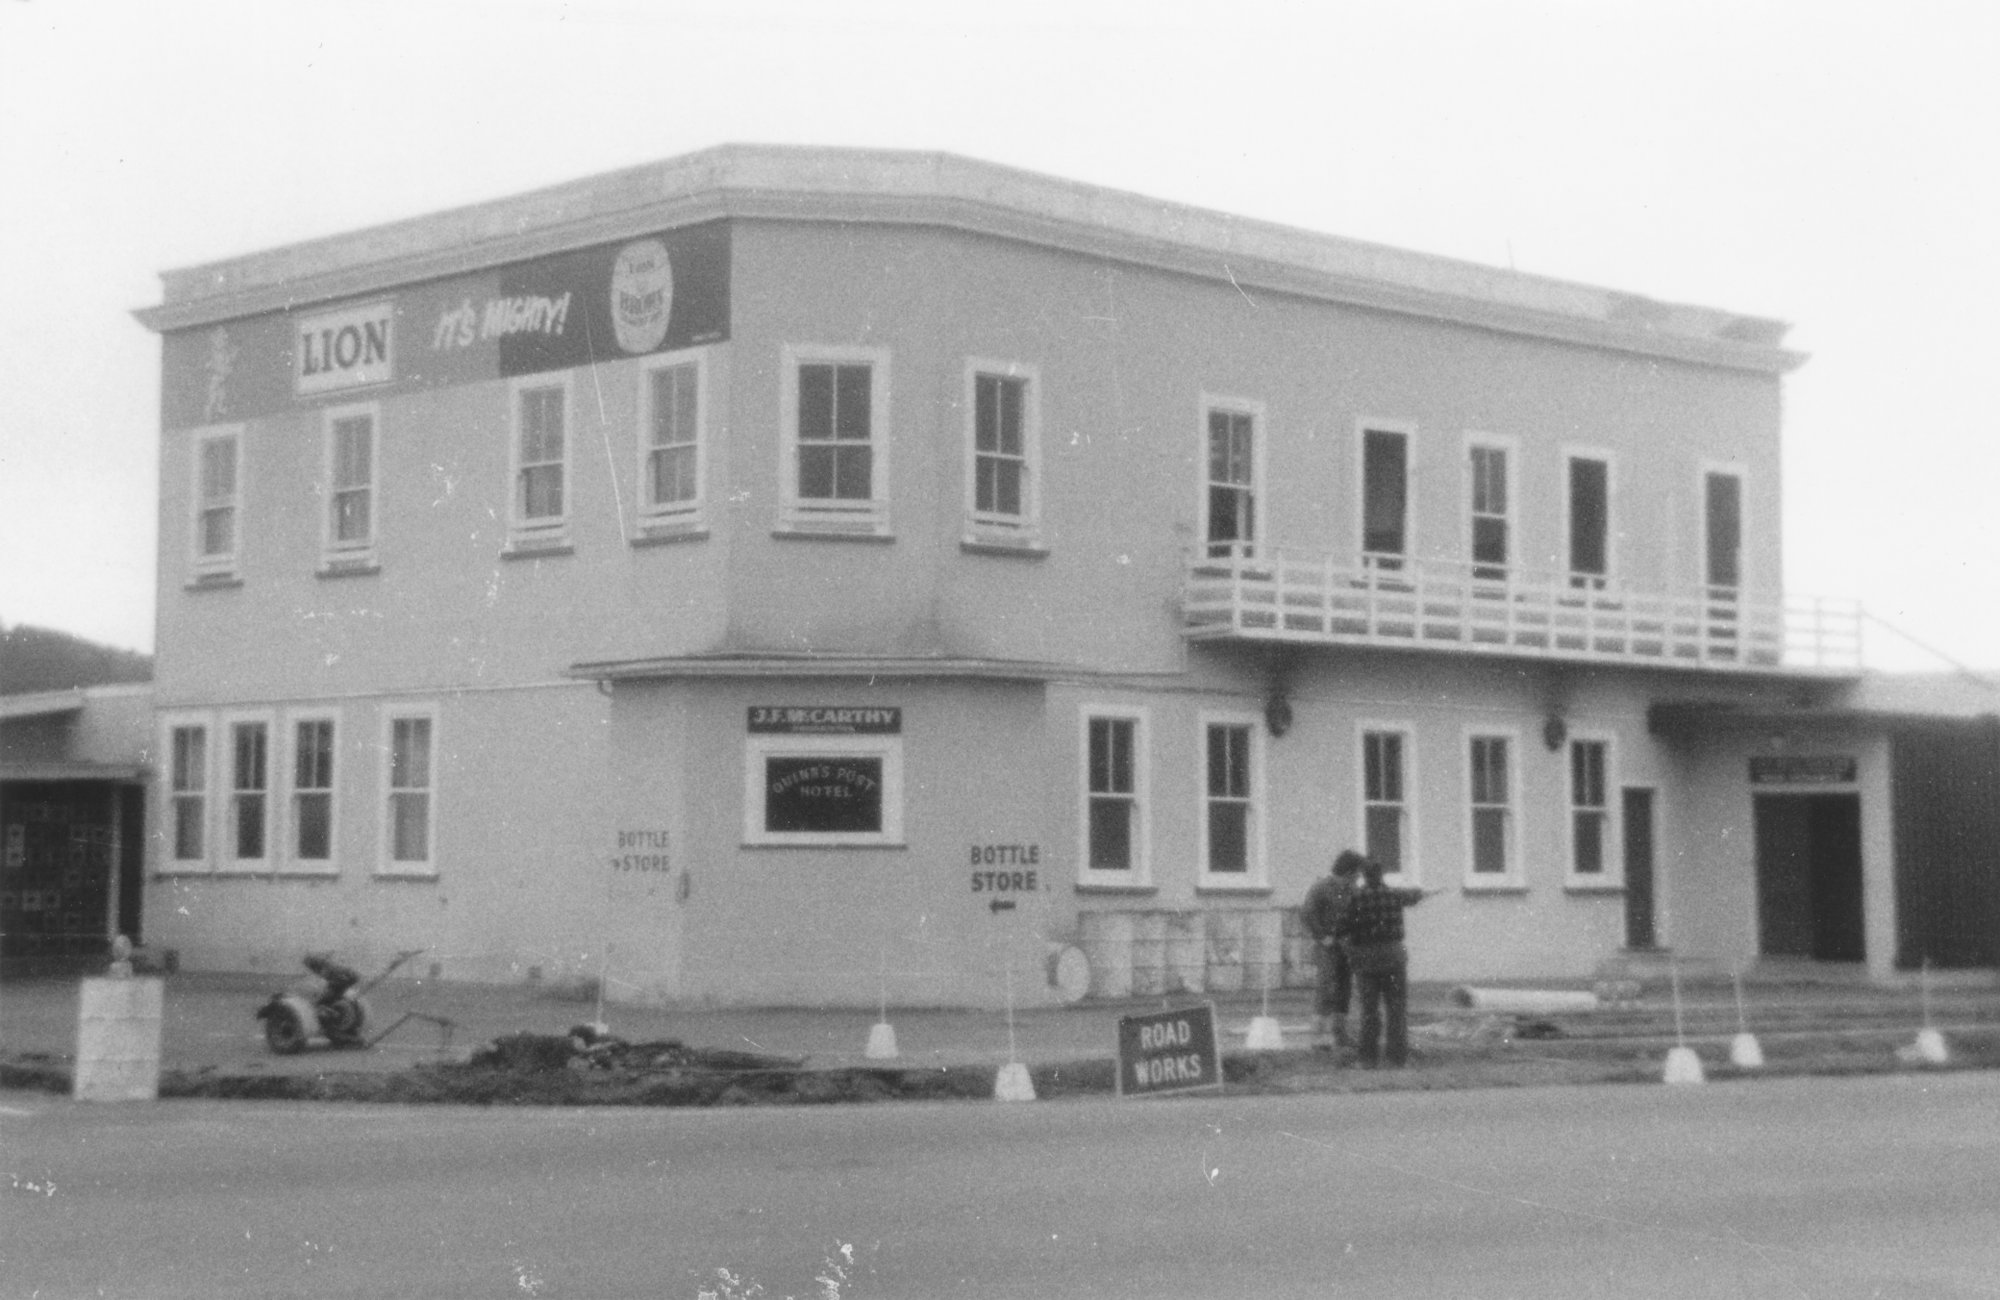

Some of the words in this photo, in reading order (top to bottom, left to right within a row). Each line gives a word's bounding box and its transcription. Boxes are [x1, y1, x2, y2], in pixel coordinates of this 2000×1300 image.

[431, 297, 476, 350] IT'S
[481, 291, 572, 340] MIGHTY!
[303, 319, 389, 376] LION
[799, 785, 853, 798] HOTEL
[618, 831, 669, 848] BOTTLE
[623, 855, 670, 872] STORE
[970, 845, 1039, 865] BOTTLE
[970, 871, 1037, 893] STORE
[1140, 1020, 1191, 1050] ROAD
[1134, 1054, 1202, 1086] WORKS
